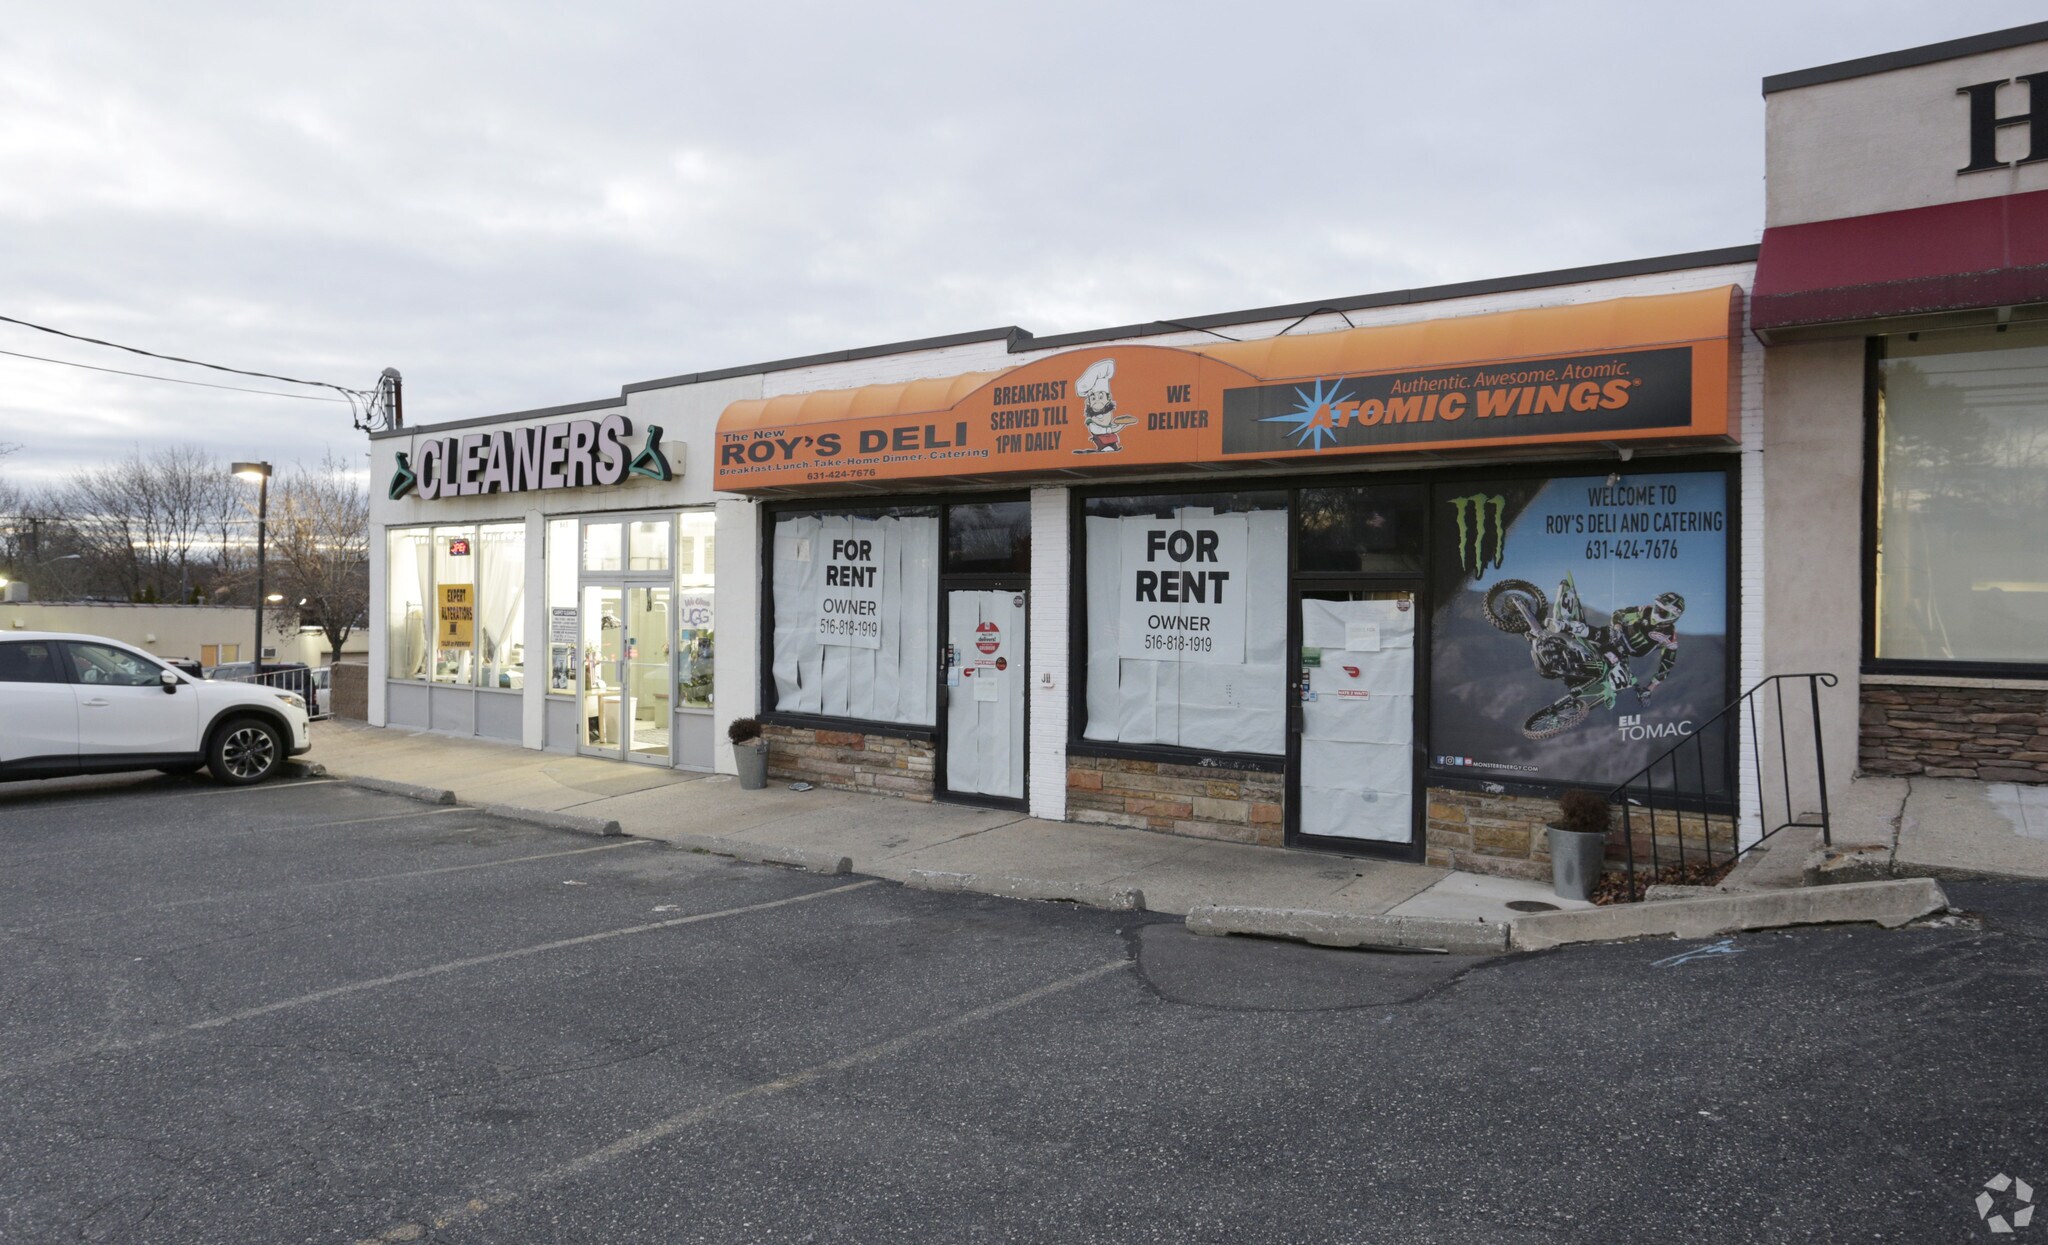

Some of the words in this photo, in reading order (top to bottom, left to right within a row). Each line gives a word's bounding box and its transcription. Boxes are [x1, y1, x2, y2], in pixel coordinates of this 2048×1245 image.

[1391, 374, 1471, 394] Authentic.
[1474, 370, 1559, 387] Awesome.
[1562, 360, 1630, 380] Atomic.
[993, 381, 1067, 405] BREAKFAST
[1167, 384, 1191, 403] WE
[991, 408, 1039, 430] SERVED
[1043, 406, 1068, 426] TILL
[1148, 410, 1208, 430] DELIVER
[1307, 392, 1467, 430] ATOMIC
[721, 433, 842, 466] ROY'S
[859, 422, 967, 453] DELI
[723, 433, 749, 442] The
[753, 430, 785, 439] New
[995, 434, 1022, 454] 1PM
[1025, 431, 1062, 452] DAILY
[416, 414, 633, 500] CLEANERS
[929, 448, 989, 460] Catering
[807, 468, 876, 480] 631-424-7676
[1588, 486, 1656, 507] WELCOME
[1660, 485, 1677, 505] TO
[1546, 515, 1584, 534] ROY'S
[1588, 514, 1617, 533] DELI
[1621, 512, 1649, 532] AND
[1654, 511, 1723, 532] CATERING
[833, 539, 872, 561] FOR
[1147, 529, 1219, 562] FOR
[1586, 539, 1678, 559] 631-424-7676
[826, 565, 877, 588] RENT
[447, 588, 466, 602] EXPERT
[1136, 570, 1229, 604] RENT
[441, 606, 473, 621] ALTERATIONS
[823, 599, 876, 616] OWNER
[820, 618, 877, 638] 516-818-1919
[1148, 615, 1210, 631] OWNER
[1145, 634, 1212, 652] 516-818-1919
[1618, 720, 1692, 741] TOMAC
[1619, 714, 1641, 727] ELI
[1472, 761, 1539, 772] MONSTERENERGY.COM
